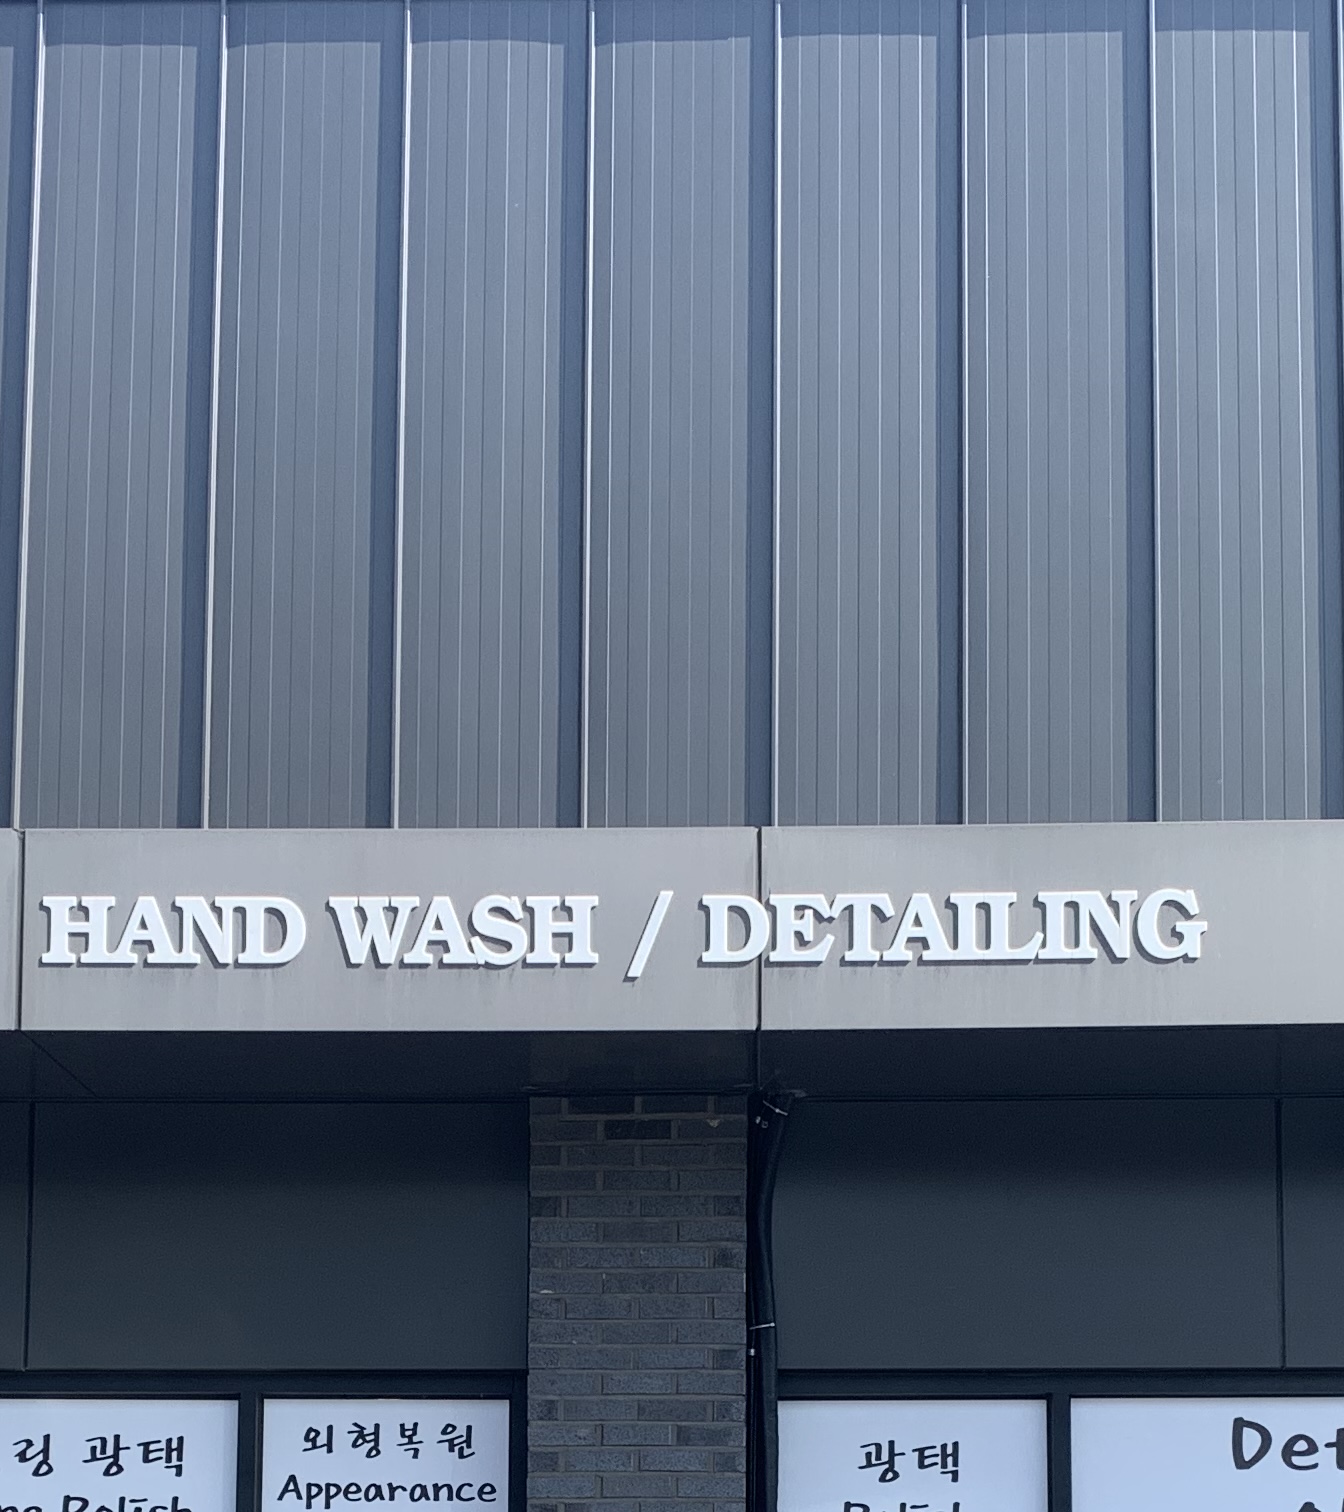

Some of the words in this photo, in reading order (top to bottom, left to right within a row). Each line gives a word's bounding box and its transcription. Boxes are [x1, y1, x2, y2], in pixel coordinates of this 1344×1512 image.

[41, 894, 307, 969] HAND
[326, 893, 598, 968] WASH
[626, 889, 673, 979] /
[697, 887, 1207, 968] DETAILING
[82, 1434, 184, 1477] 광택
[303, 1422, 475, 1459] 외형복원
[858, 1440, 959, 1483] 광택
[277, 1475, 496, 1509] Appearance
